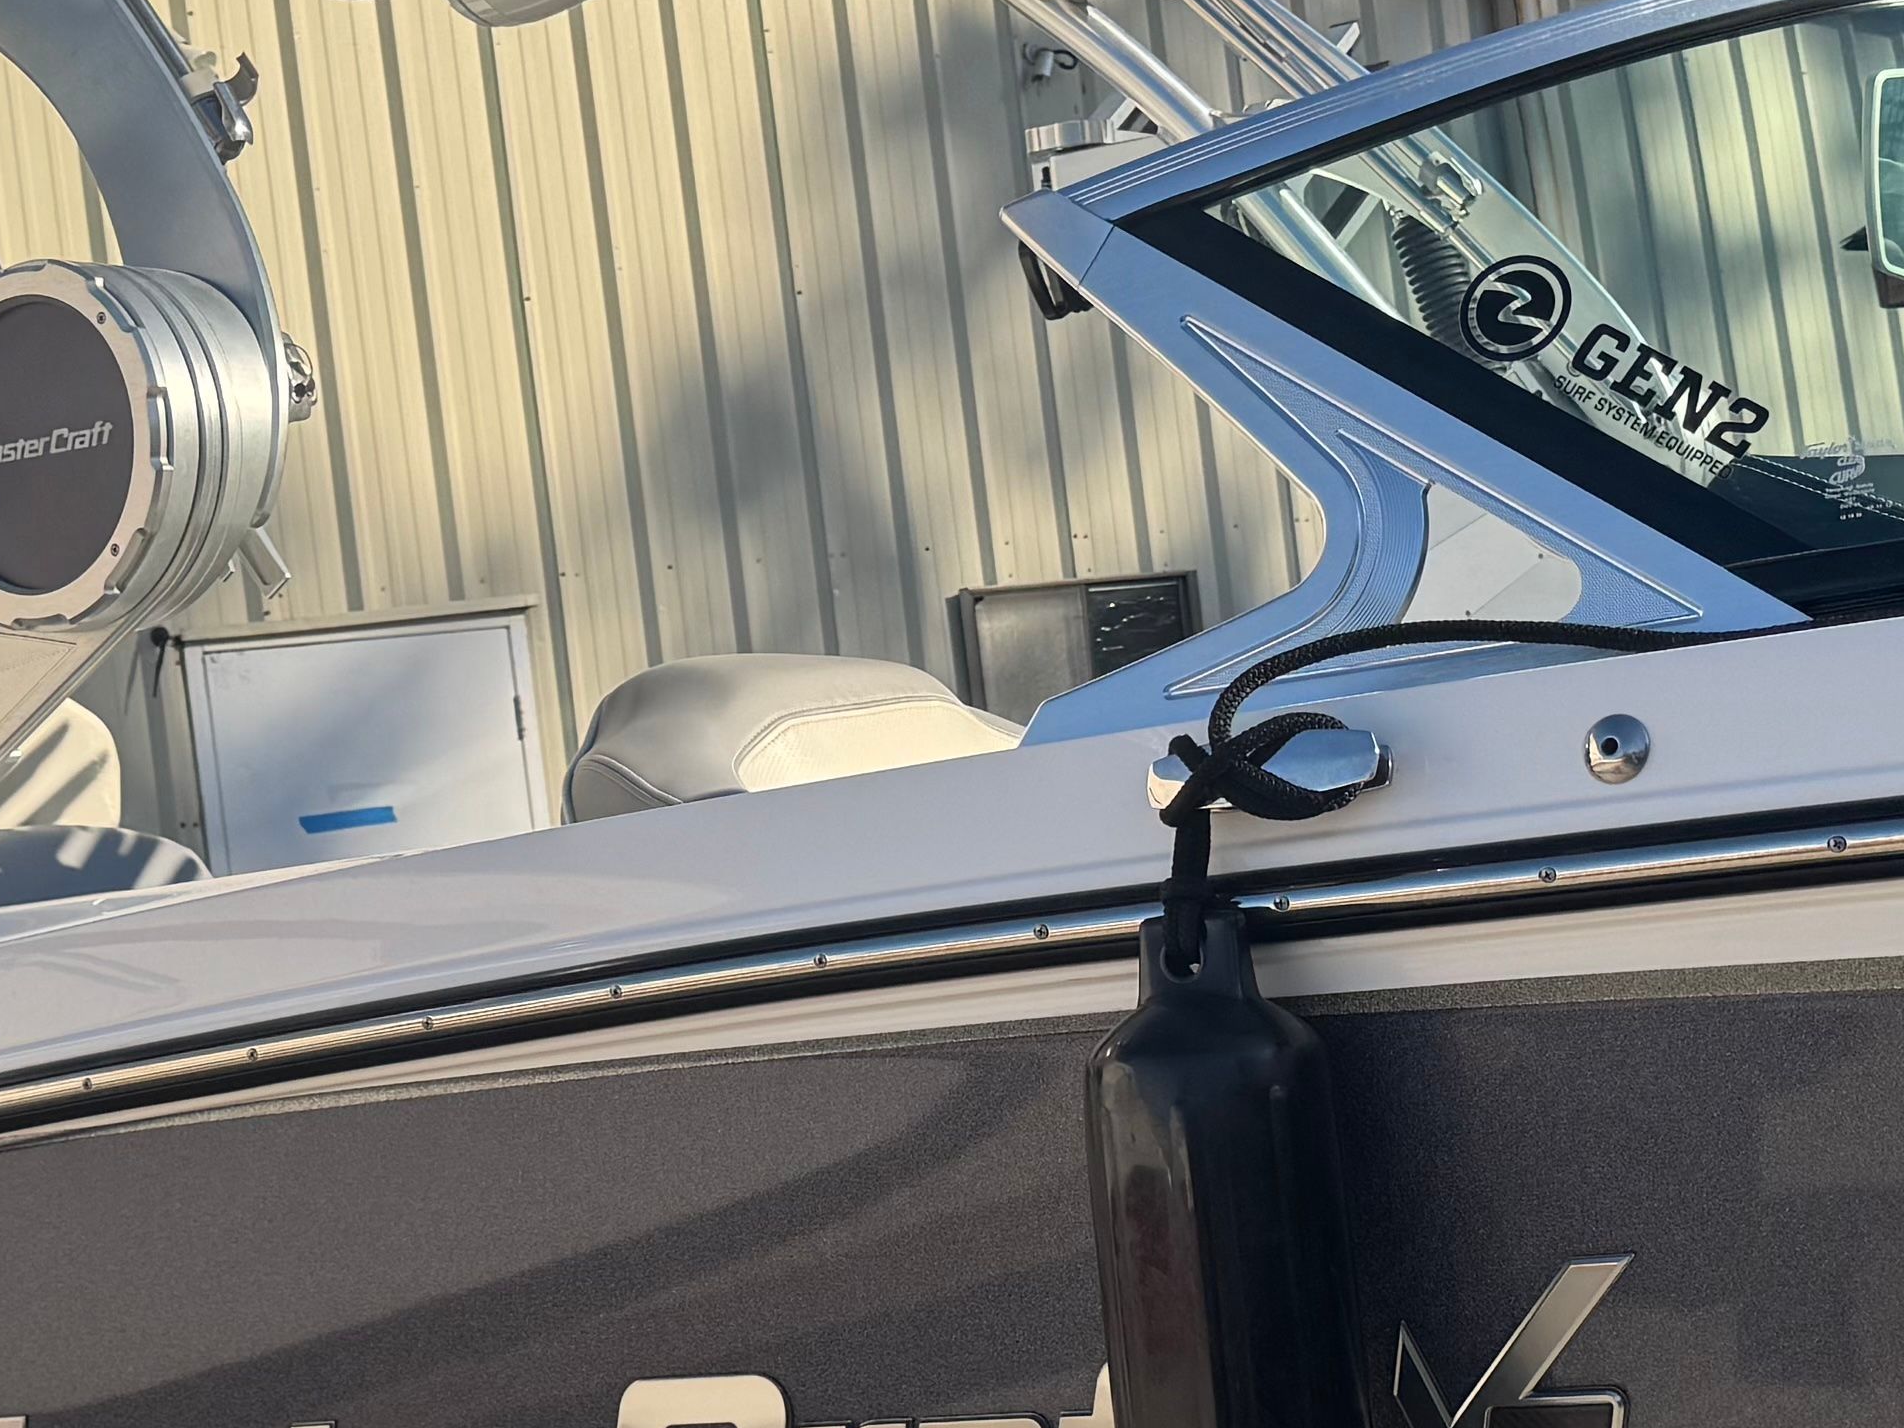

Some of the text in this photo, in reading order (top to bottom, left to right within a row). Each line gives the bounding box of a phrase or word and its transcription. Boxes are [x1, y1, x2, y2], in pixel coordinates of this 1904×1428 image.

[1553, 375, 1735, 481] SURF SYSTEM EQUIPPED
[1572, 323, 1770, 459] GEN2
